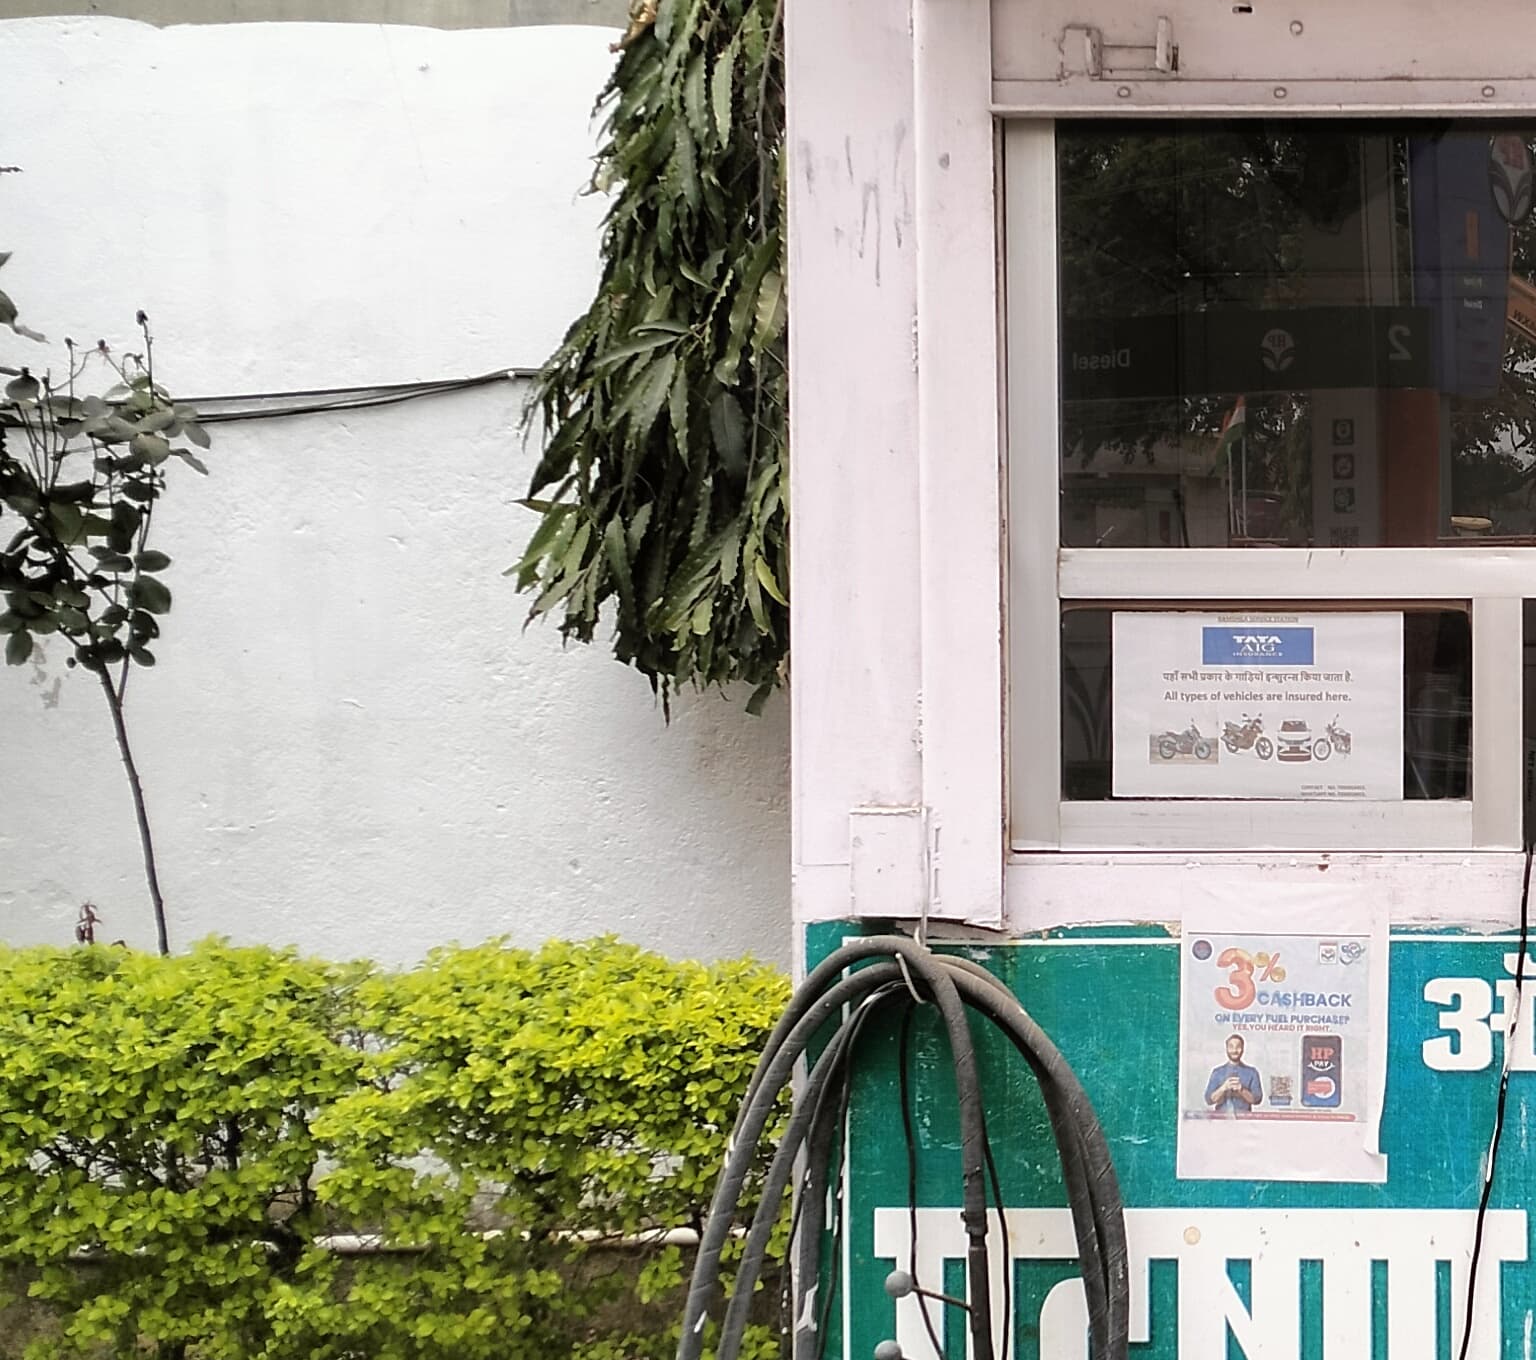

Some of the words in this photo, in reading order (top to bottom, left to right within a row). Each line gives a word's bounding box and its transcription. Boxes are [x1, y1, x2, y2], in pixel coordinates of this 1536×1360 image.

[1232, 634, 1282, 644] TATA
[1240, 643, 1275, 653] AIG
[1181, 670, 1198, 681] सभी
[1200, 671, 1222, 682] प्रकार
[1225, 670, 1233, 681] के
[1300, 671, 1321, 682] किया
[1323, 673, 1343, 682] जाता
[1164, 691, 1178, 701] All
[1181, 692, 1208, 703] types
[1211, 691, 1221, 701] of
[1223, 691, 1263, 701] vehicles
[1266, 693, 1282, 701] are
[1325, 691, 1352, 701] here.
[1214, 947, 1287, 1010] 3%
[1257, 991, 1352, 1008] CASHBACK
[1214, 1013, 1230, 1023] ON
[1232, 1014, 1264, 1023] EVERY
[1265, 1015, 1288, 1024] FUEL
[1268, 1024, 1295, 1032] HEARD
[1311, 1047, 1334, 1060] HP
